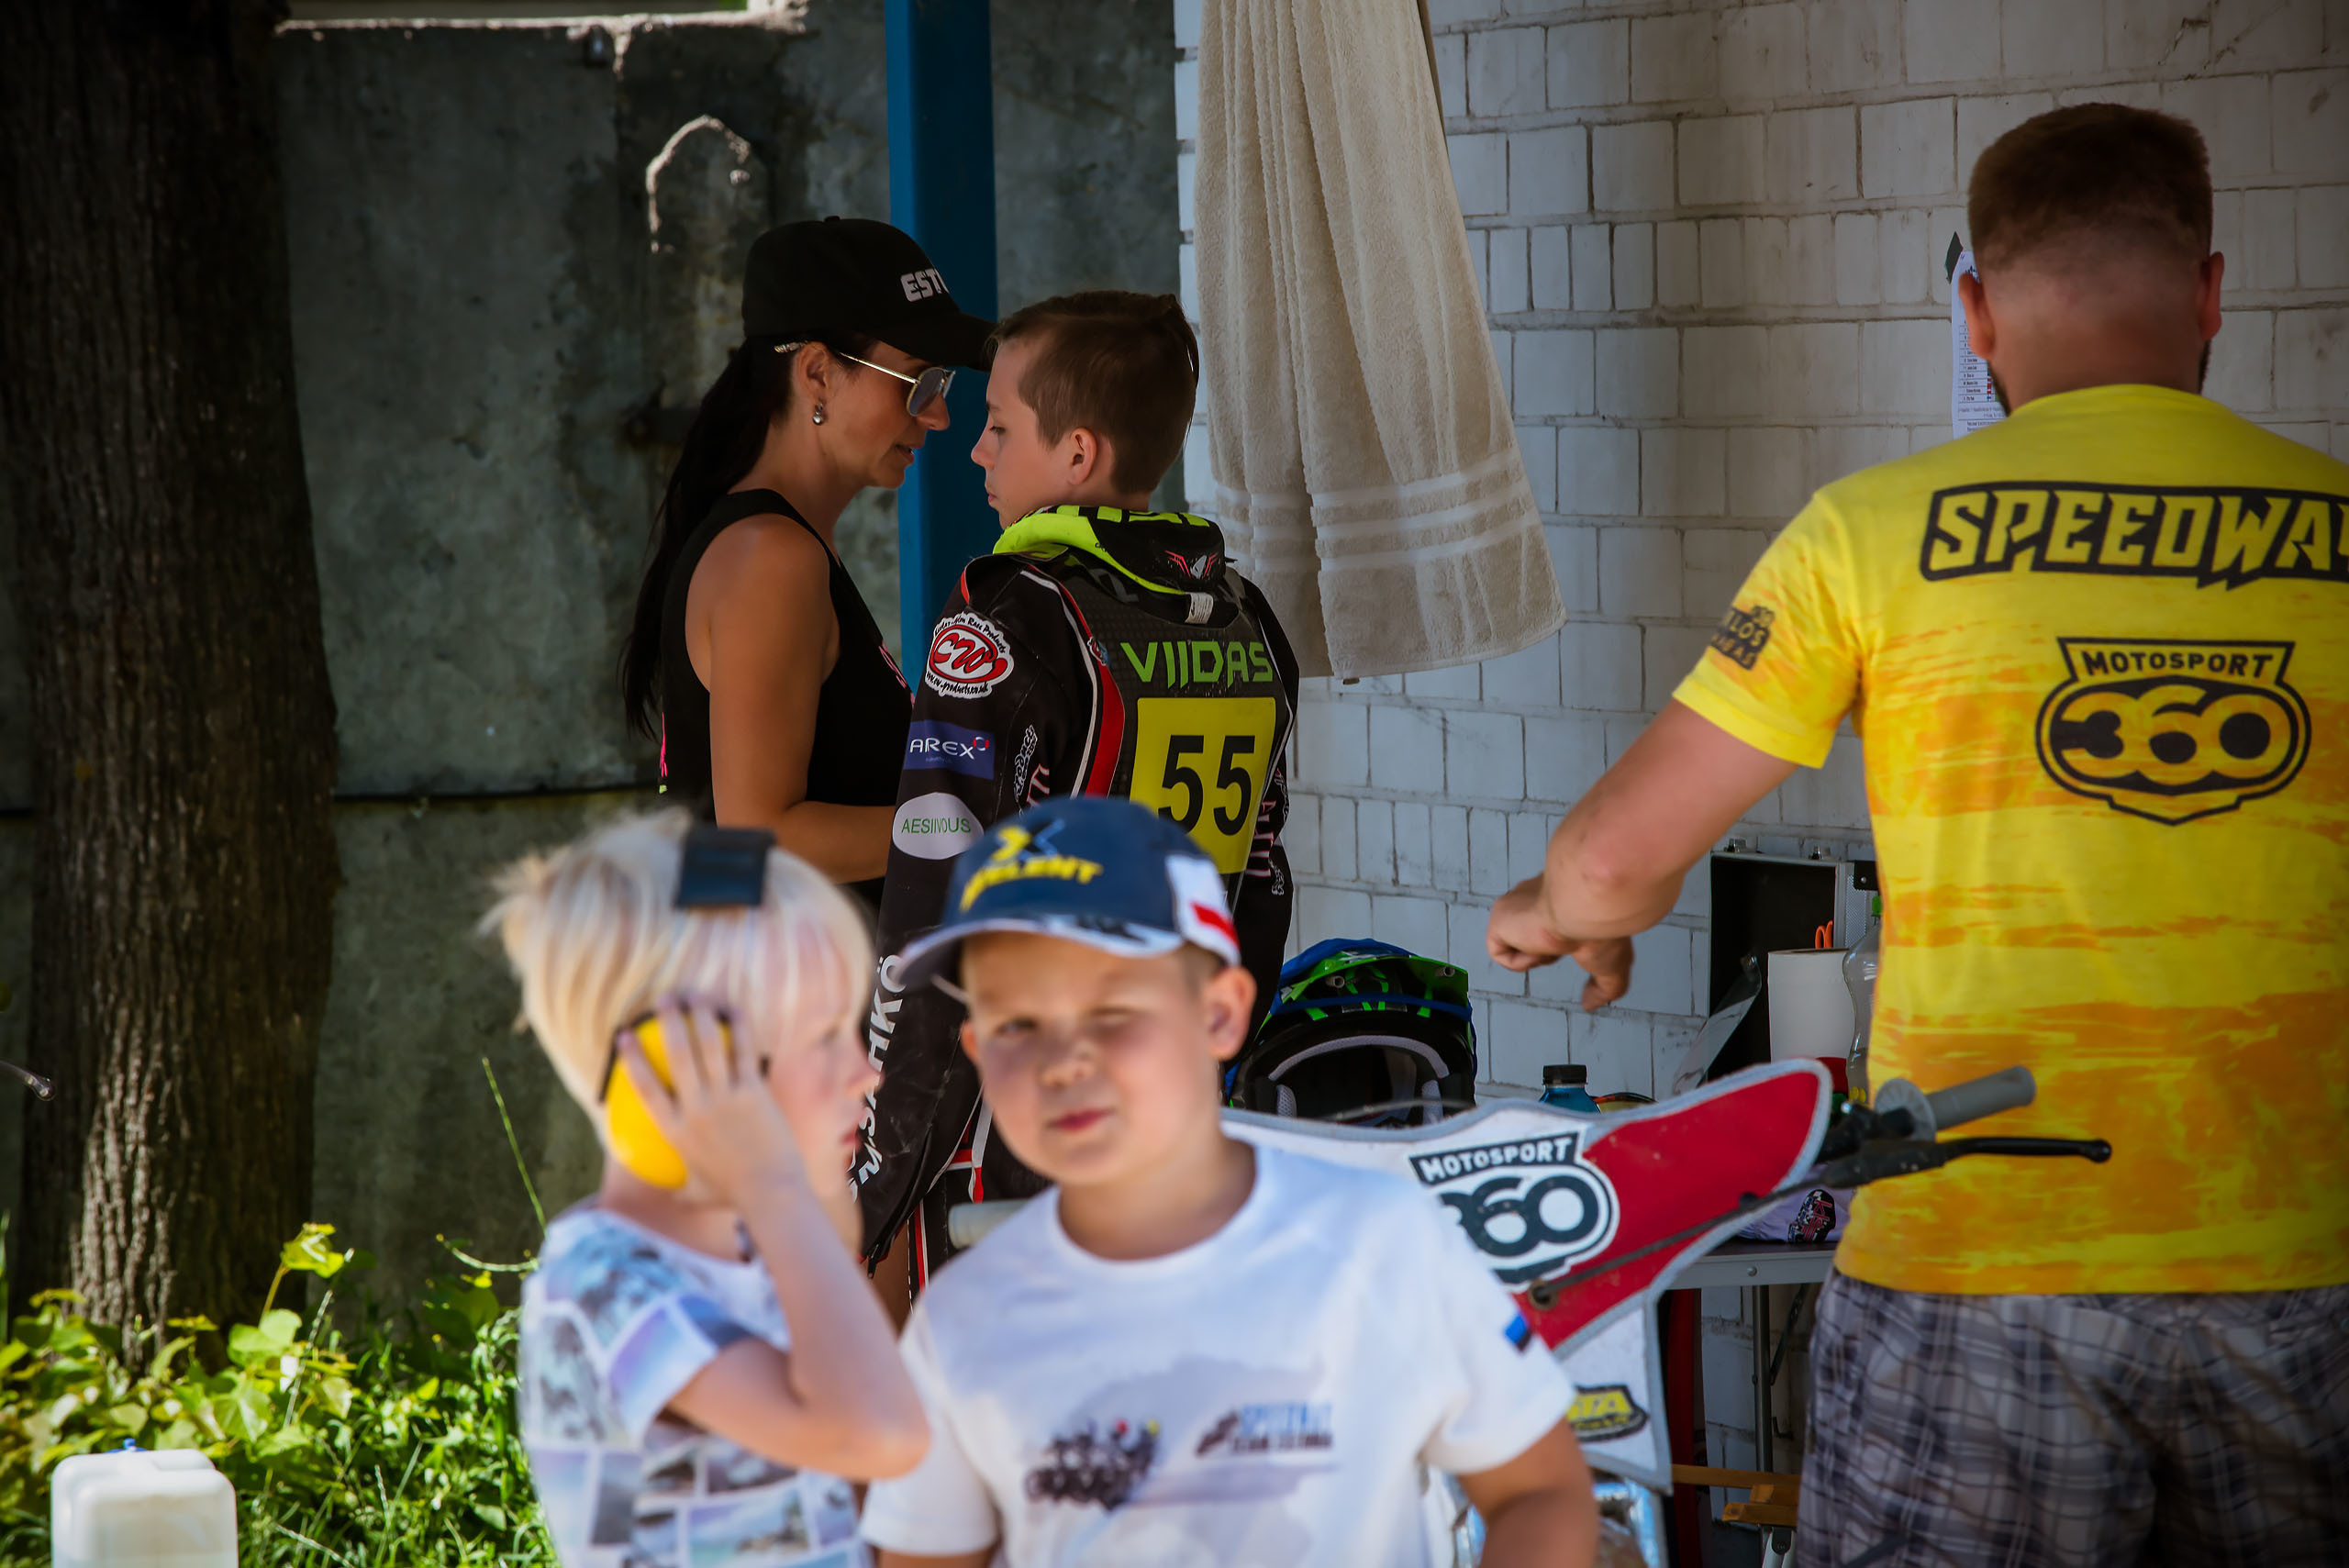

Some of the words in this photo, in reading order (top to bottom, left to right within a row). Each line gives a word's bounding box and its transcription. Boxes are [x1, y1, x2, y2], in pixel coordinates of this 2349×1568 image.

[1927, 489, 2349, 578] SPEEDWA
[1119, 640, 1274, 689] VIIDAS
[2083, 650, 2274, 677] MOTOSPORT
[909, 737, 975, 761] AREX
[2059, 683, 2293, 784] 360
[1158, 735, 1256, 836] 55
[1419, 1136, 1573, 1184] MOTOSPORT
